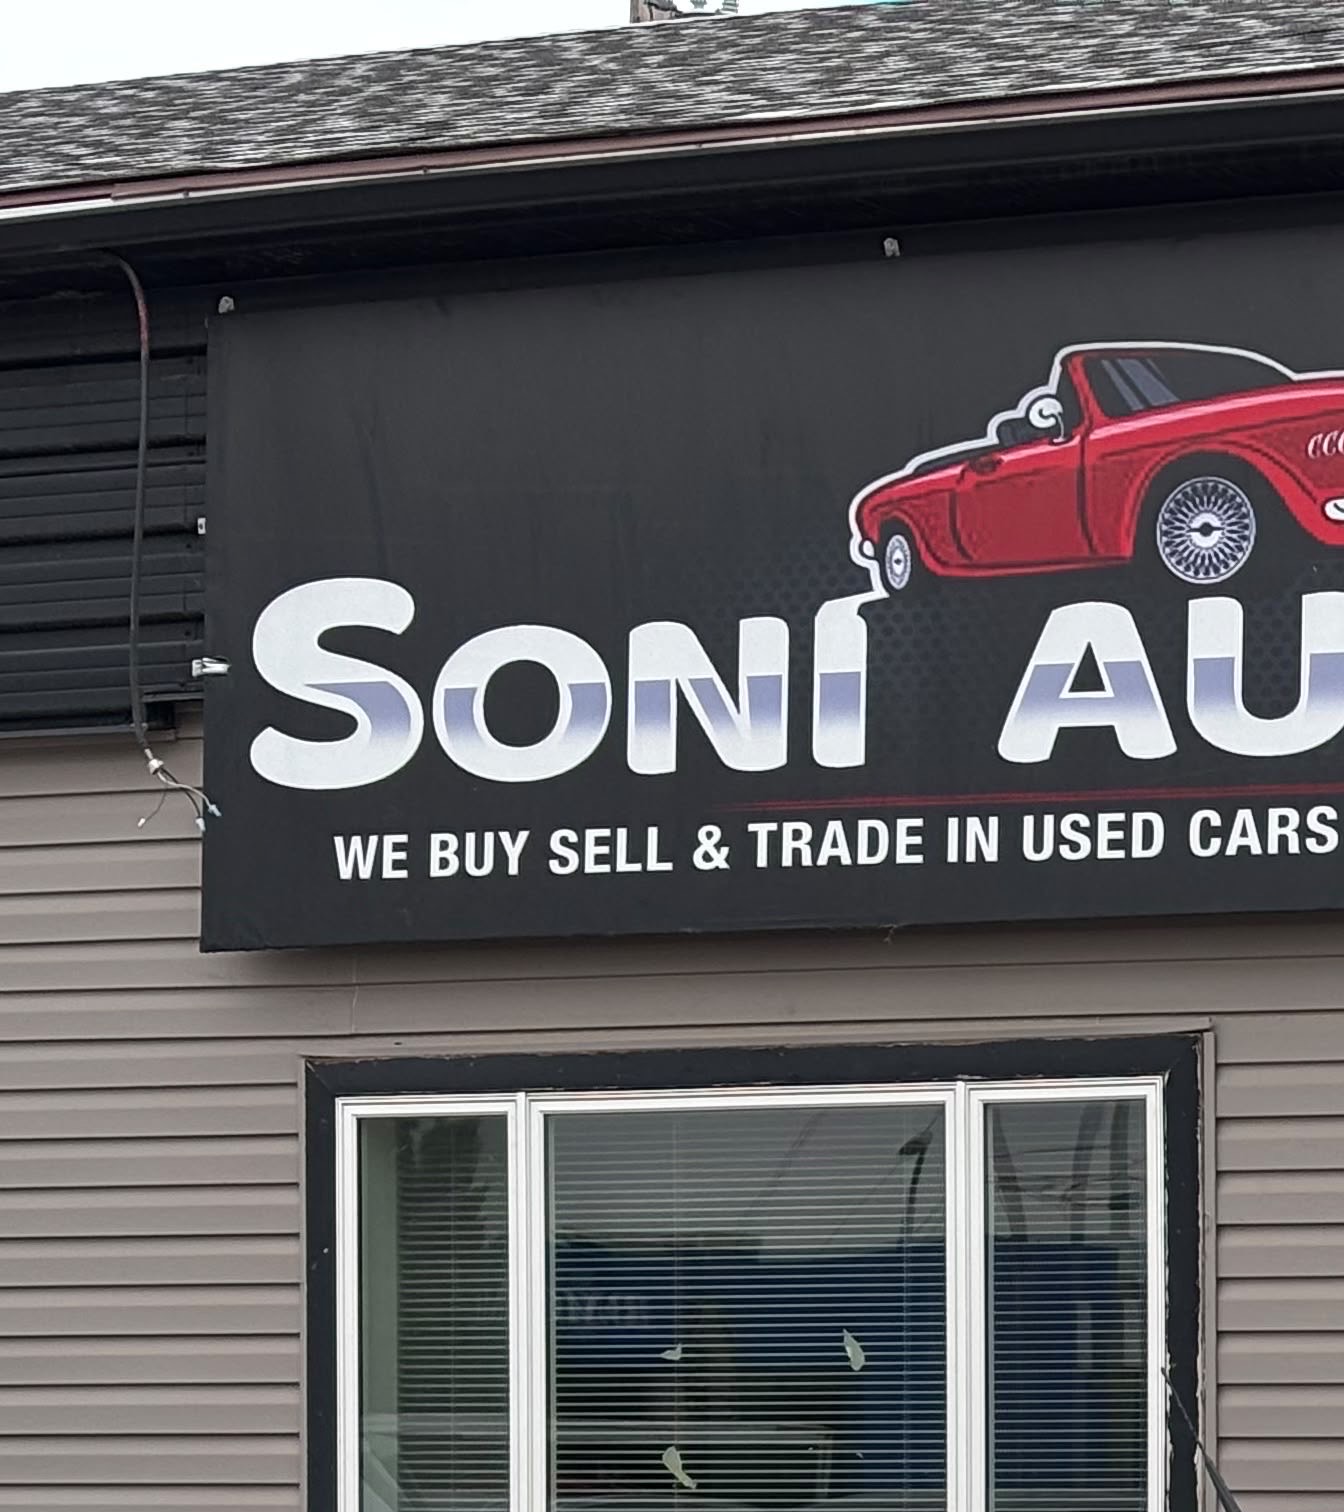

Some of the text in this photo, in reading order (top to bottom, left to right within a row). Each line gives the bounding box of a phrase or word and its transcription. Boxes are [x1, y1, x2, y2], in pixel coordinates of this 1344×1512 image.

[249, 577, 869, 790] SONI
[333, 834, 409, 880] WE
[429, 830, 530, 878] BUY
[548, 826, 674, 875] SELL
[692, 823, 730, 871] &
[747, 817, 924, 869] TRADE
[946, 816, 999, 863] IN
[1022, 811, 1165, 862] USED
[1189, 805, 1339, 858] CARS
